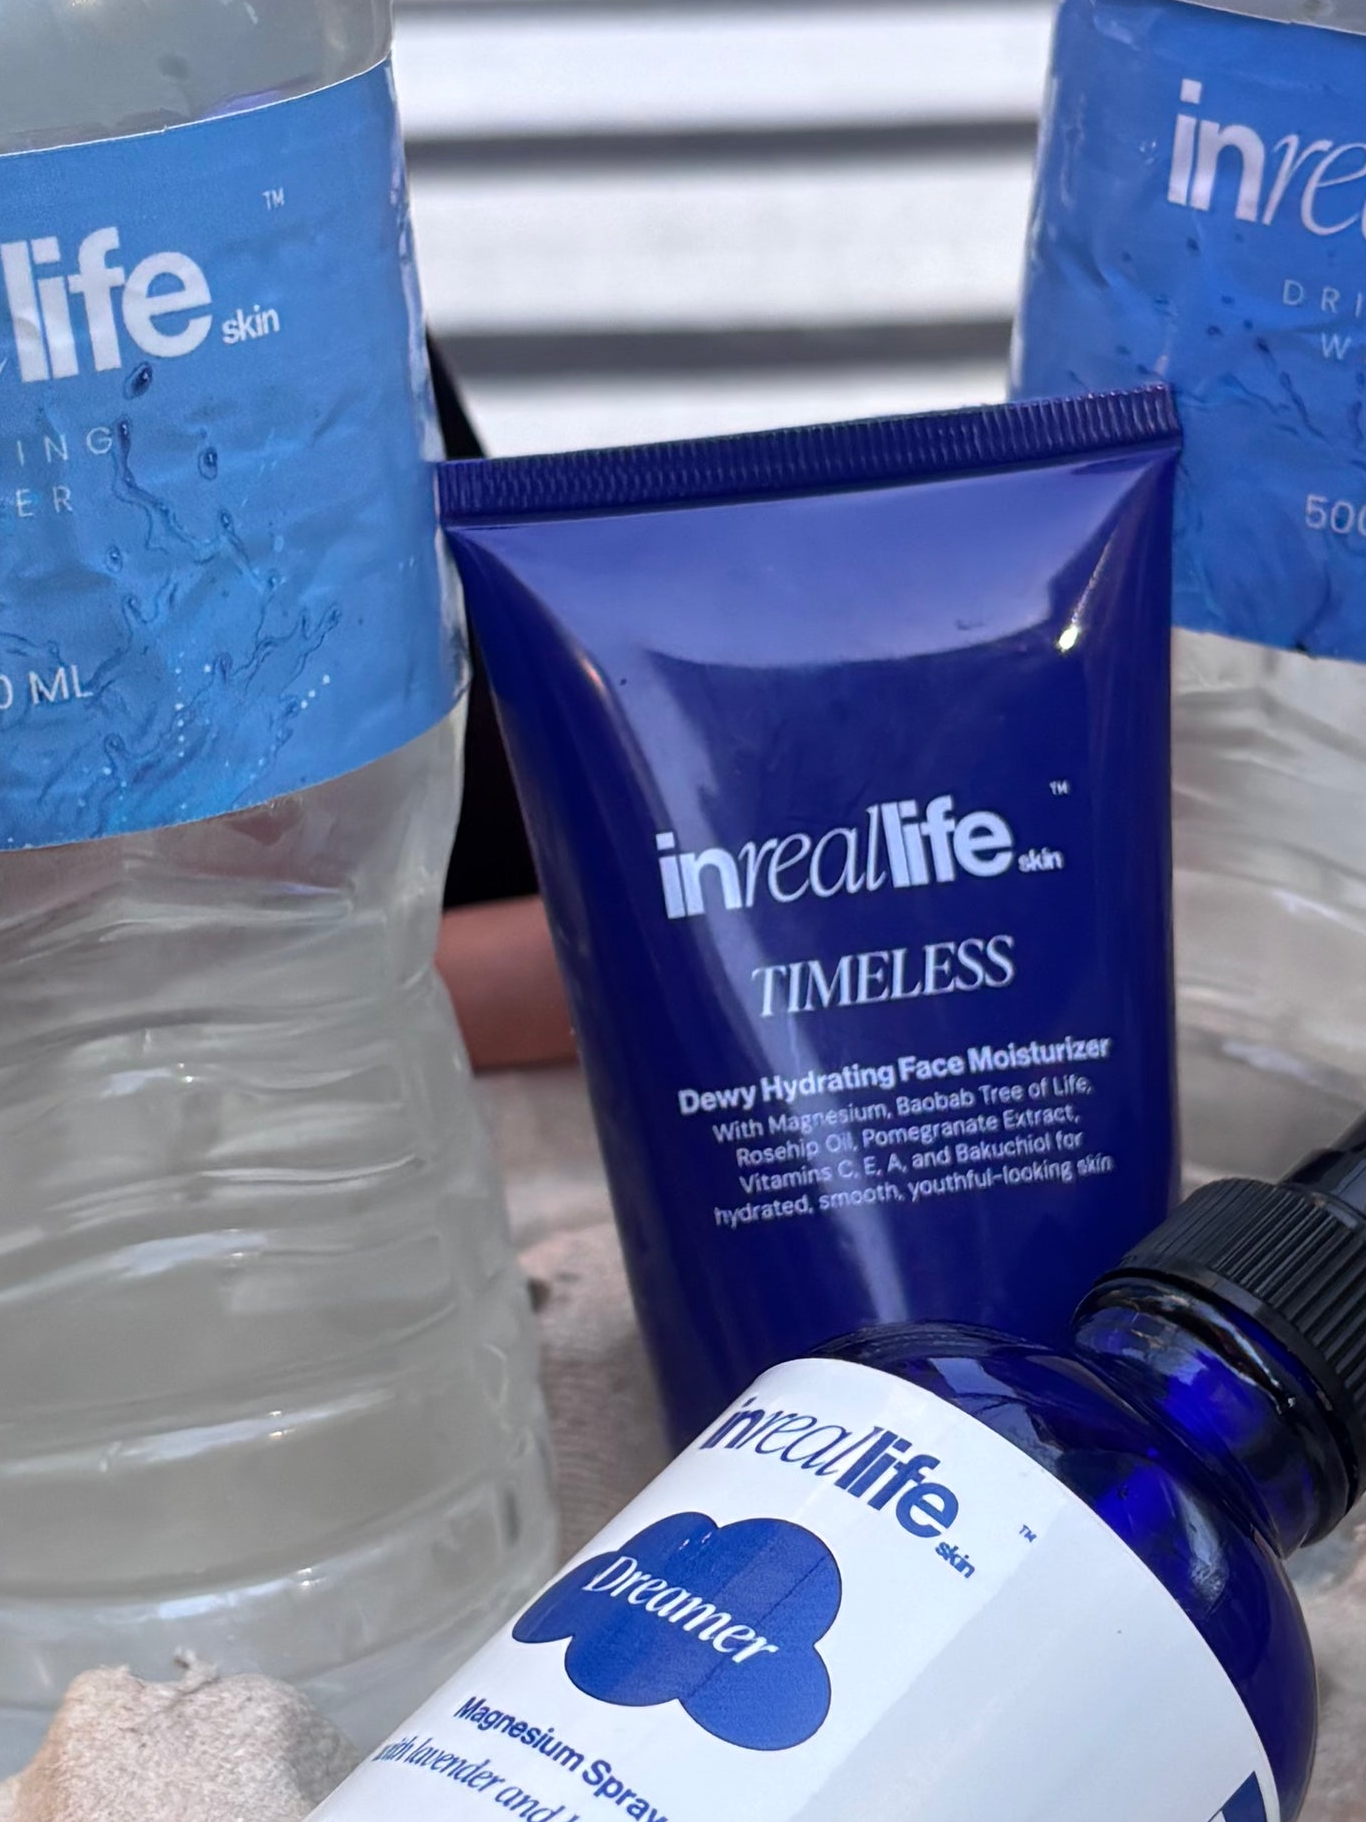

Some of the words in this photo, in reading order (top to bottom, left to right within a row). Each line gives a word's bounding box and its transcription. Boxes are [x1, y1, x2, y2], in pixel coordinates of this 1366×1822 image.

[221, 304, 280, 346] skin
[28, 665, 93, 705] ML
[1018, 847, 1064, 873] skin
[751, 934, 1015, 1017] TIMELESS
[678, 1085, 757, 1116] Dewy
[760, 1063, 897, 1103] Hydrating
[897, 1055, 965, 1082] Face
[967, 1035, 1111, 1074] Moisturizer
[712, 1118, 765, 1144] With
[767, 1102, 893, 1134] Magnesium,
[895, 1088, 976, 1117] Baobab
[978, 1083, 1024, 1106] Tree
[1027, 1077, 1049, 1099] of
[735, 1138, 819, 1168] Rosehip
[862, 1114, 999, 1149] Pomegranate
[1002, 1103, 1081, 1130] Extract,
[713, 1194, 814, 1229] hydrated,
[818, 1181, 905, 1211] smooth,
[1076, 1152, 1115, 1177] skin
[738, 1165, 832, 1195] Vitamins
[911, 1146, 952, 1170] and
[954, 1131, 1051, 1164] Bakuchiol
[1054, 1129, 1083, 1150] for
[934, 1541, 976, 1578] skin
[581, 1556, 780, 1664] Dreamer
[407, 1736, 507, 1794] lavender
[453, 1696, 585, 1773] Magnesium
